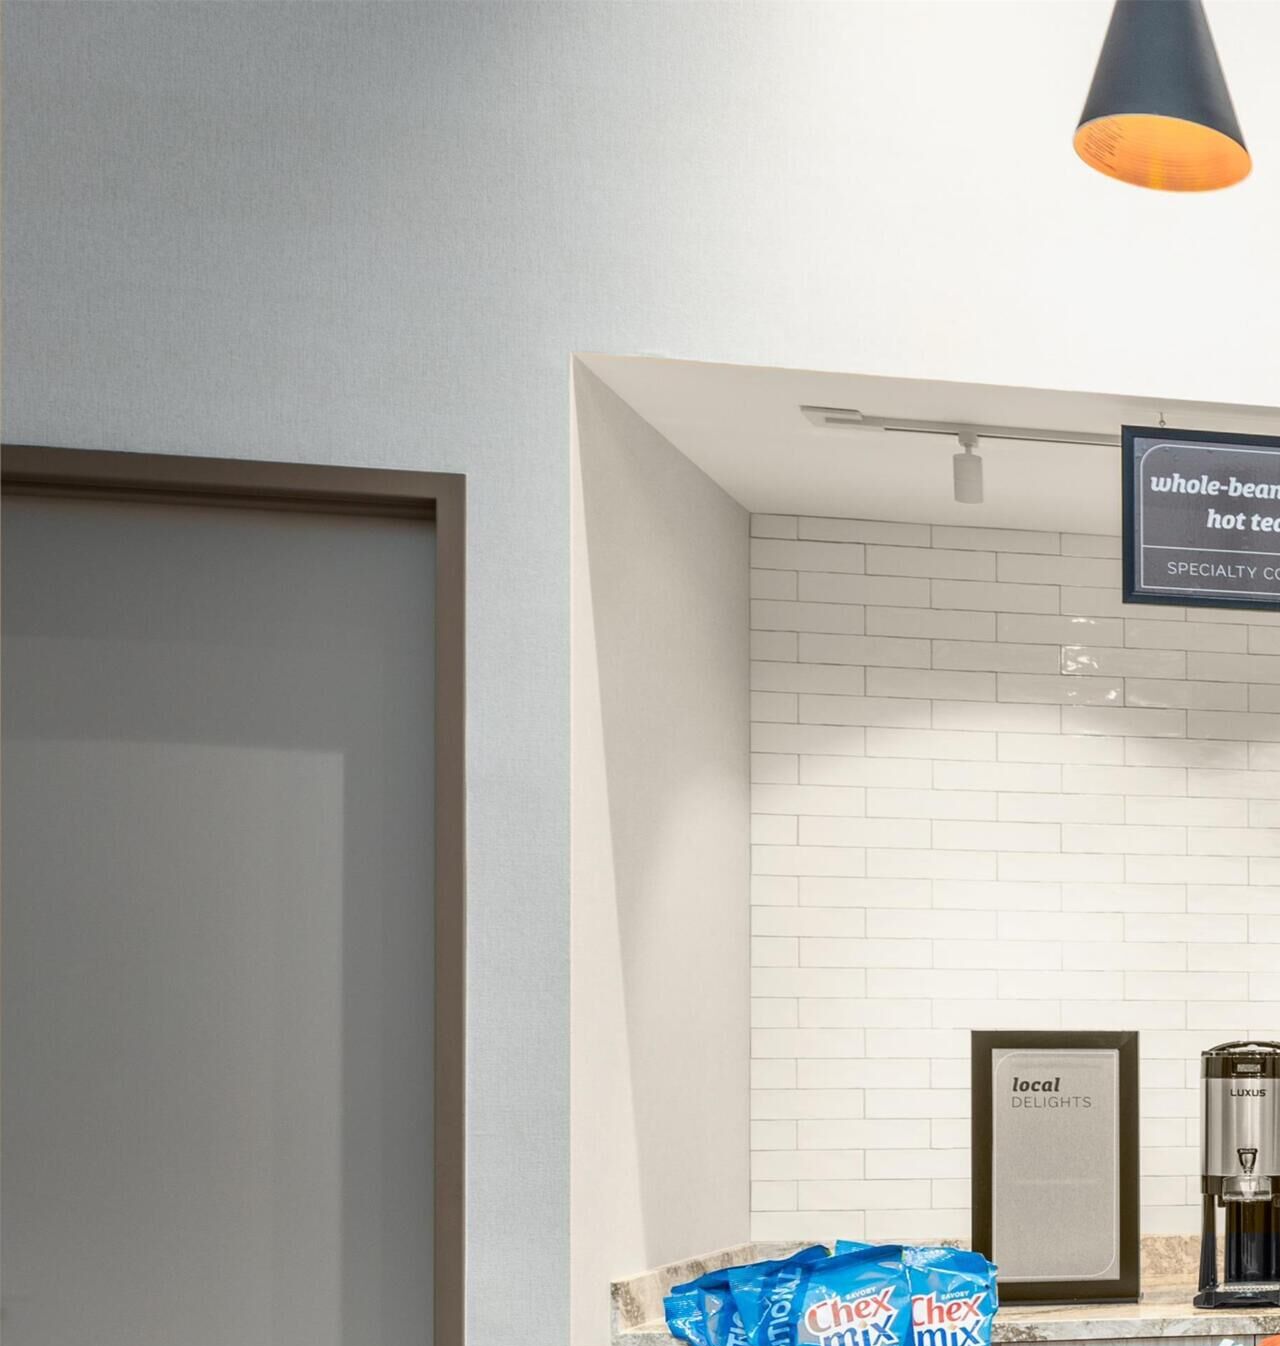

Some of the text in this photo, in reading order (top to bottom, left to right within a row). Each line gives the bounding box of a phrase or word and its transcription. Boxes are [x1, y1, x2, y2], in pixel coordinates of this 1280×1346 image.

[1206, 510, 1246, 530] hot
[1167, 561, 1256, 579] SPECIALTY
[1012, 1077, 1060, 1092] local
[1230, 1088, 1266, 1097] LUXUS
[1011, 1096, 1092, 1108] DELIGHTS
[808, 1288, 892, 1333] Chex
[912, 1294, 982, 1327] Chex
